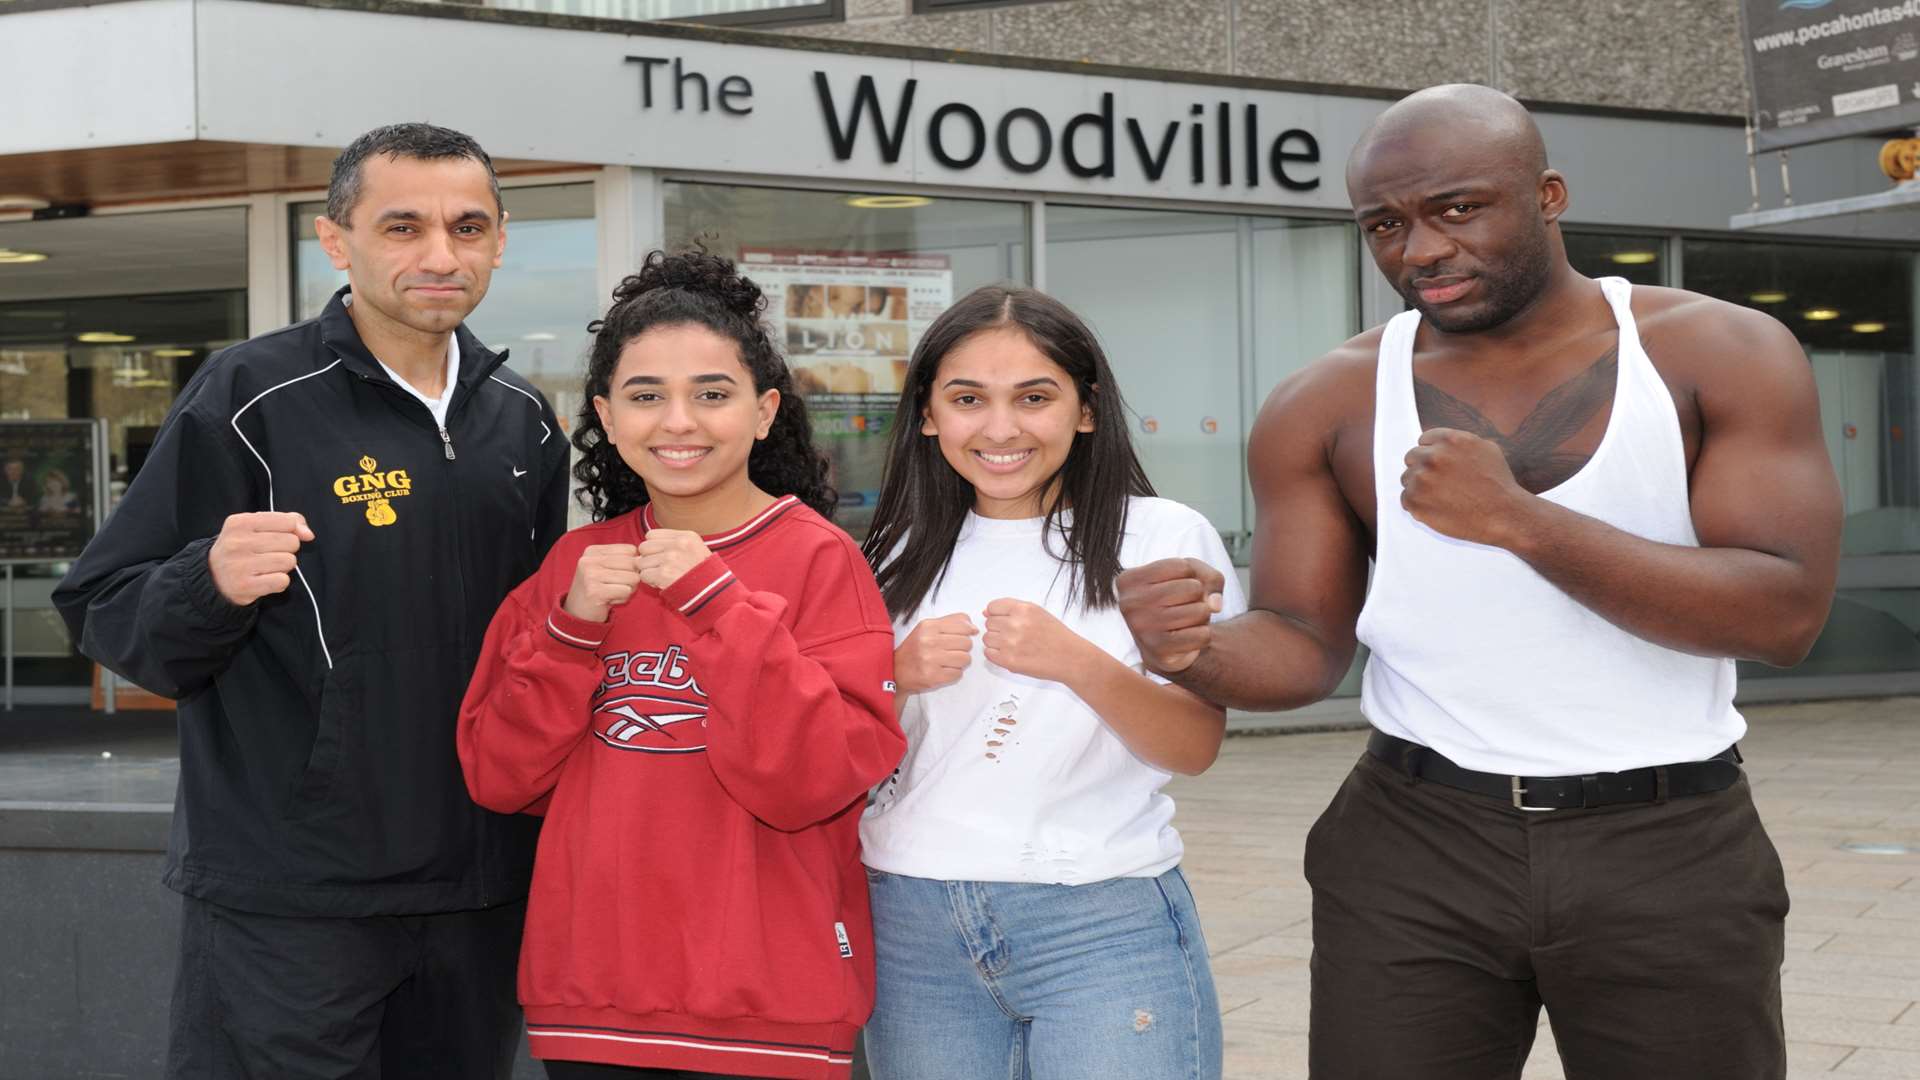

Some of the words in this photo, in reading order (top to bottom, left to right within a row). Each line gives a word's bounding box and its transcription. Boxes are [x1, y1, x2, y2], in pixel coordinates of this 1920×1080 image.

[1817, 45, 1889, 70] Gravesham
[624, 54, 755, 117] The
[813, 70, 1322, 192] Woodville
[802, 330, 894, 350] LION
[333, 469, 412, 497] GNG
[341, 491, 382, 504] BOXING
[383, 488, 411, 498] CLUB
[593, 644, 708, 699] eeb
